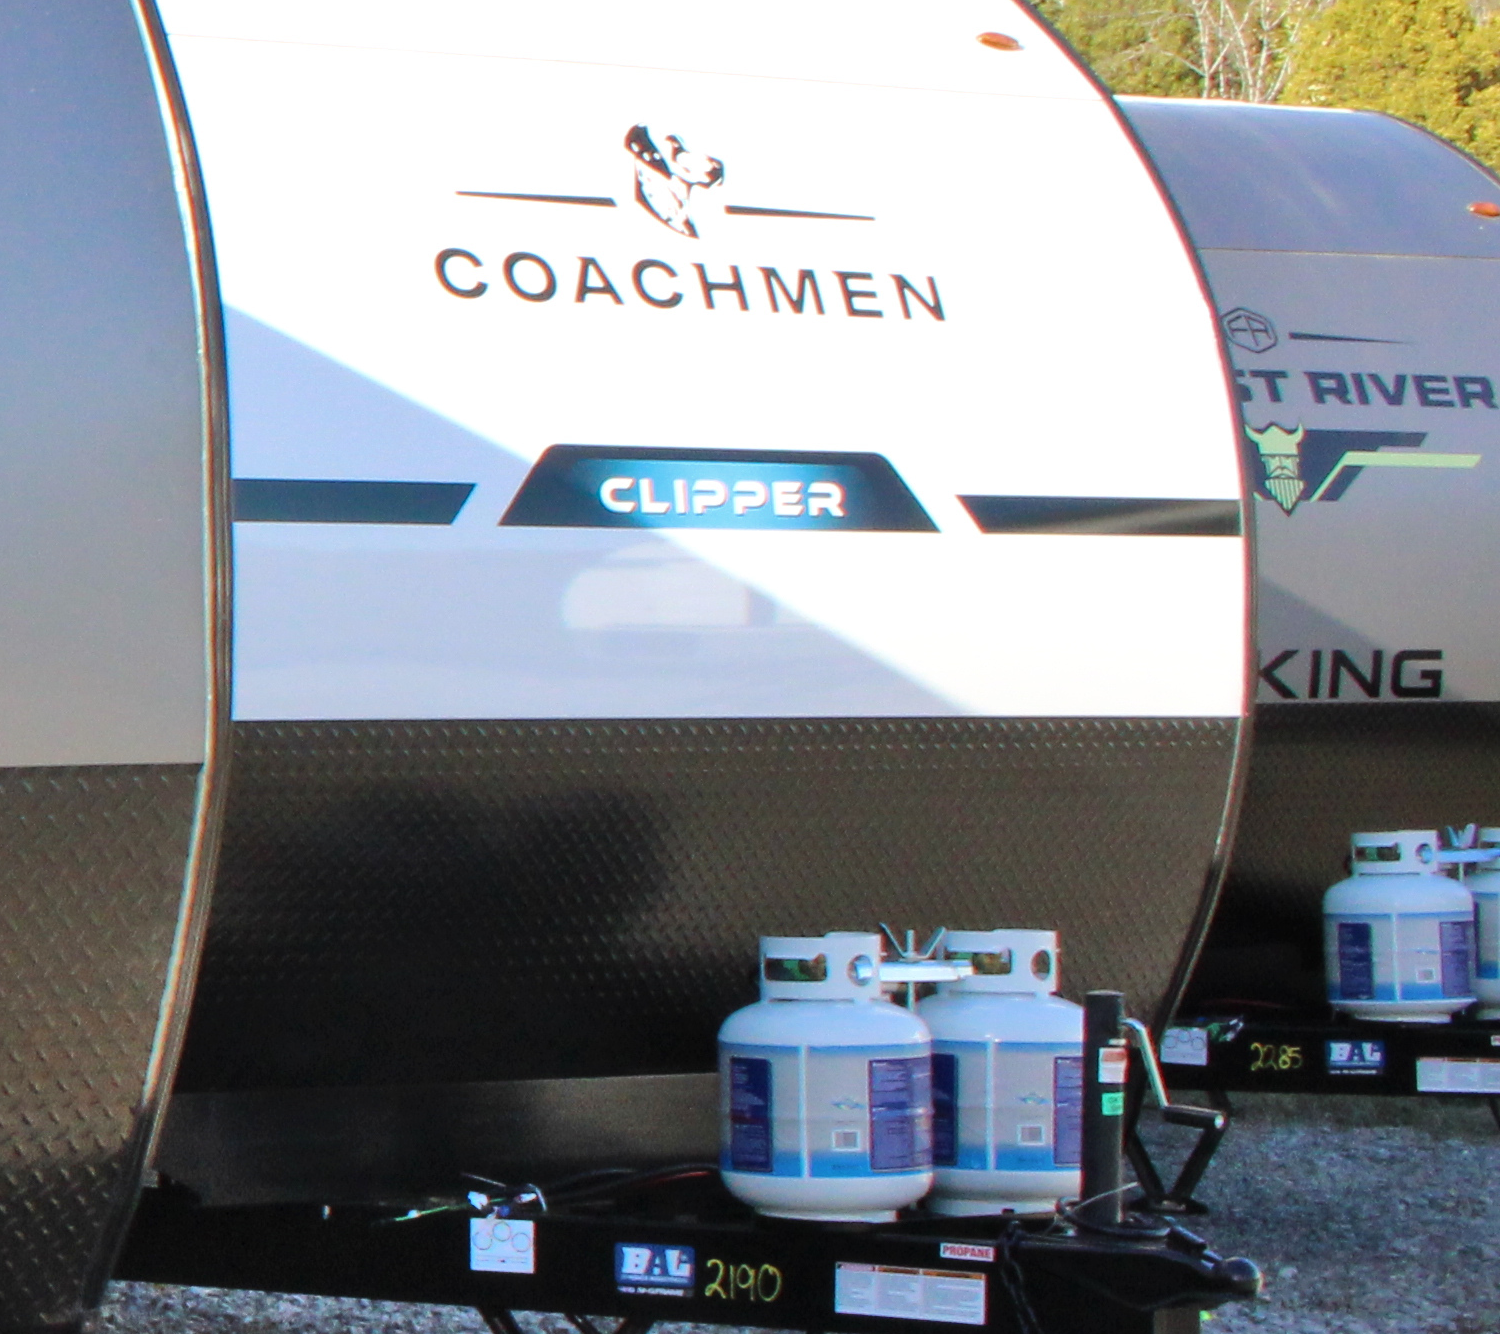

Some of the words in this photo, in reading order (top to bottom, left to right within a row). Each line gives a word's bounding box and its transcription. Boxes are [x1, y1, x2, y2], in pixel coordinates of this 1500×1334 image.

[433, 246, 947, 322] COACHMEN
[1303, 371, 1499, 409] RIVER
[599, 476, 847, 518] CLIPPER
[621, 1246, 692, 1278] BAL
[942, 1244, 991, 1259] PROPANE
[704, 1258, 783, 1303] 2190
